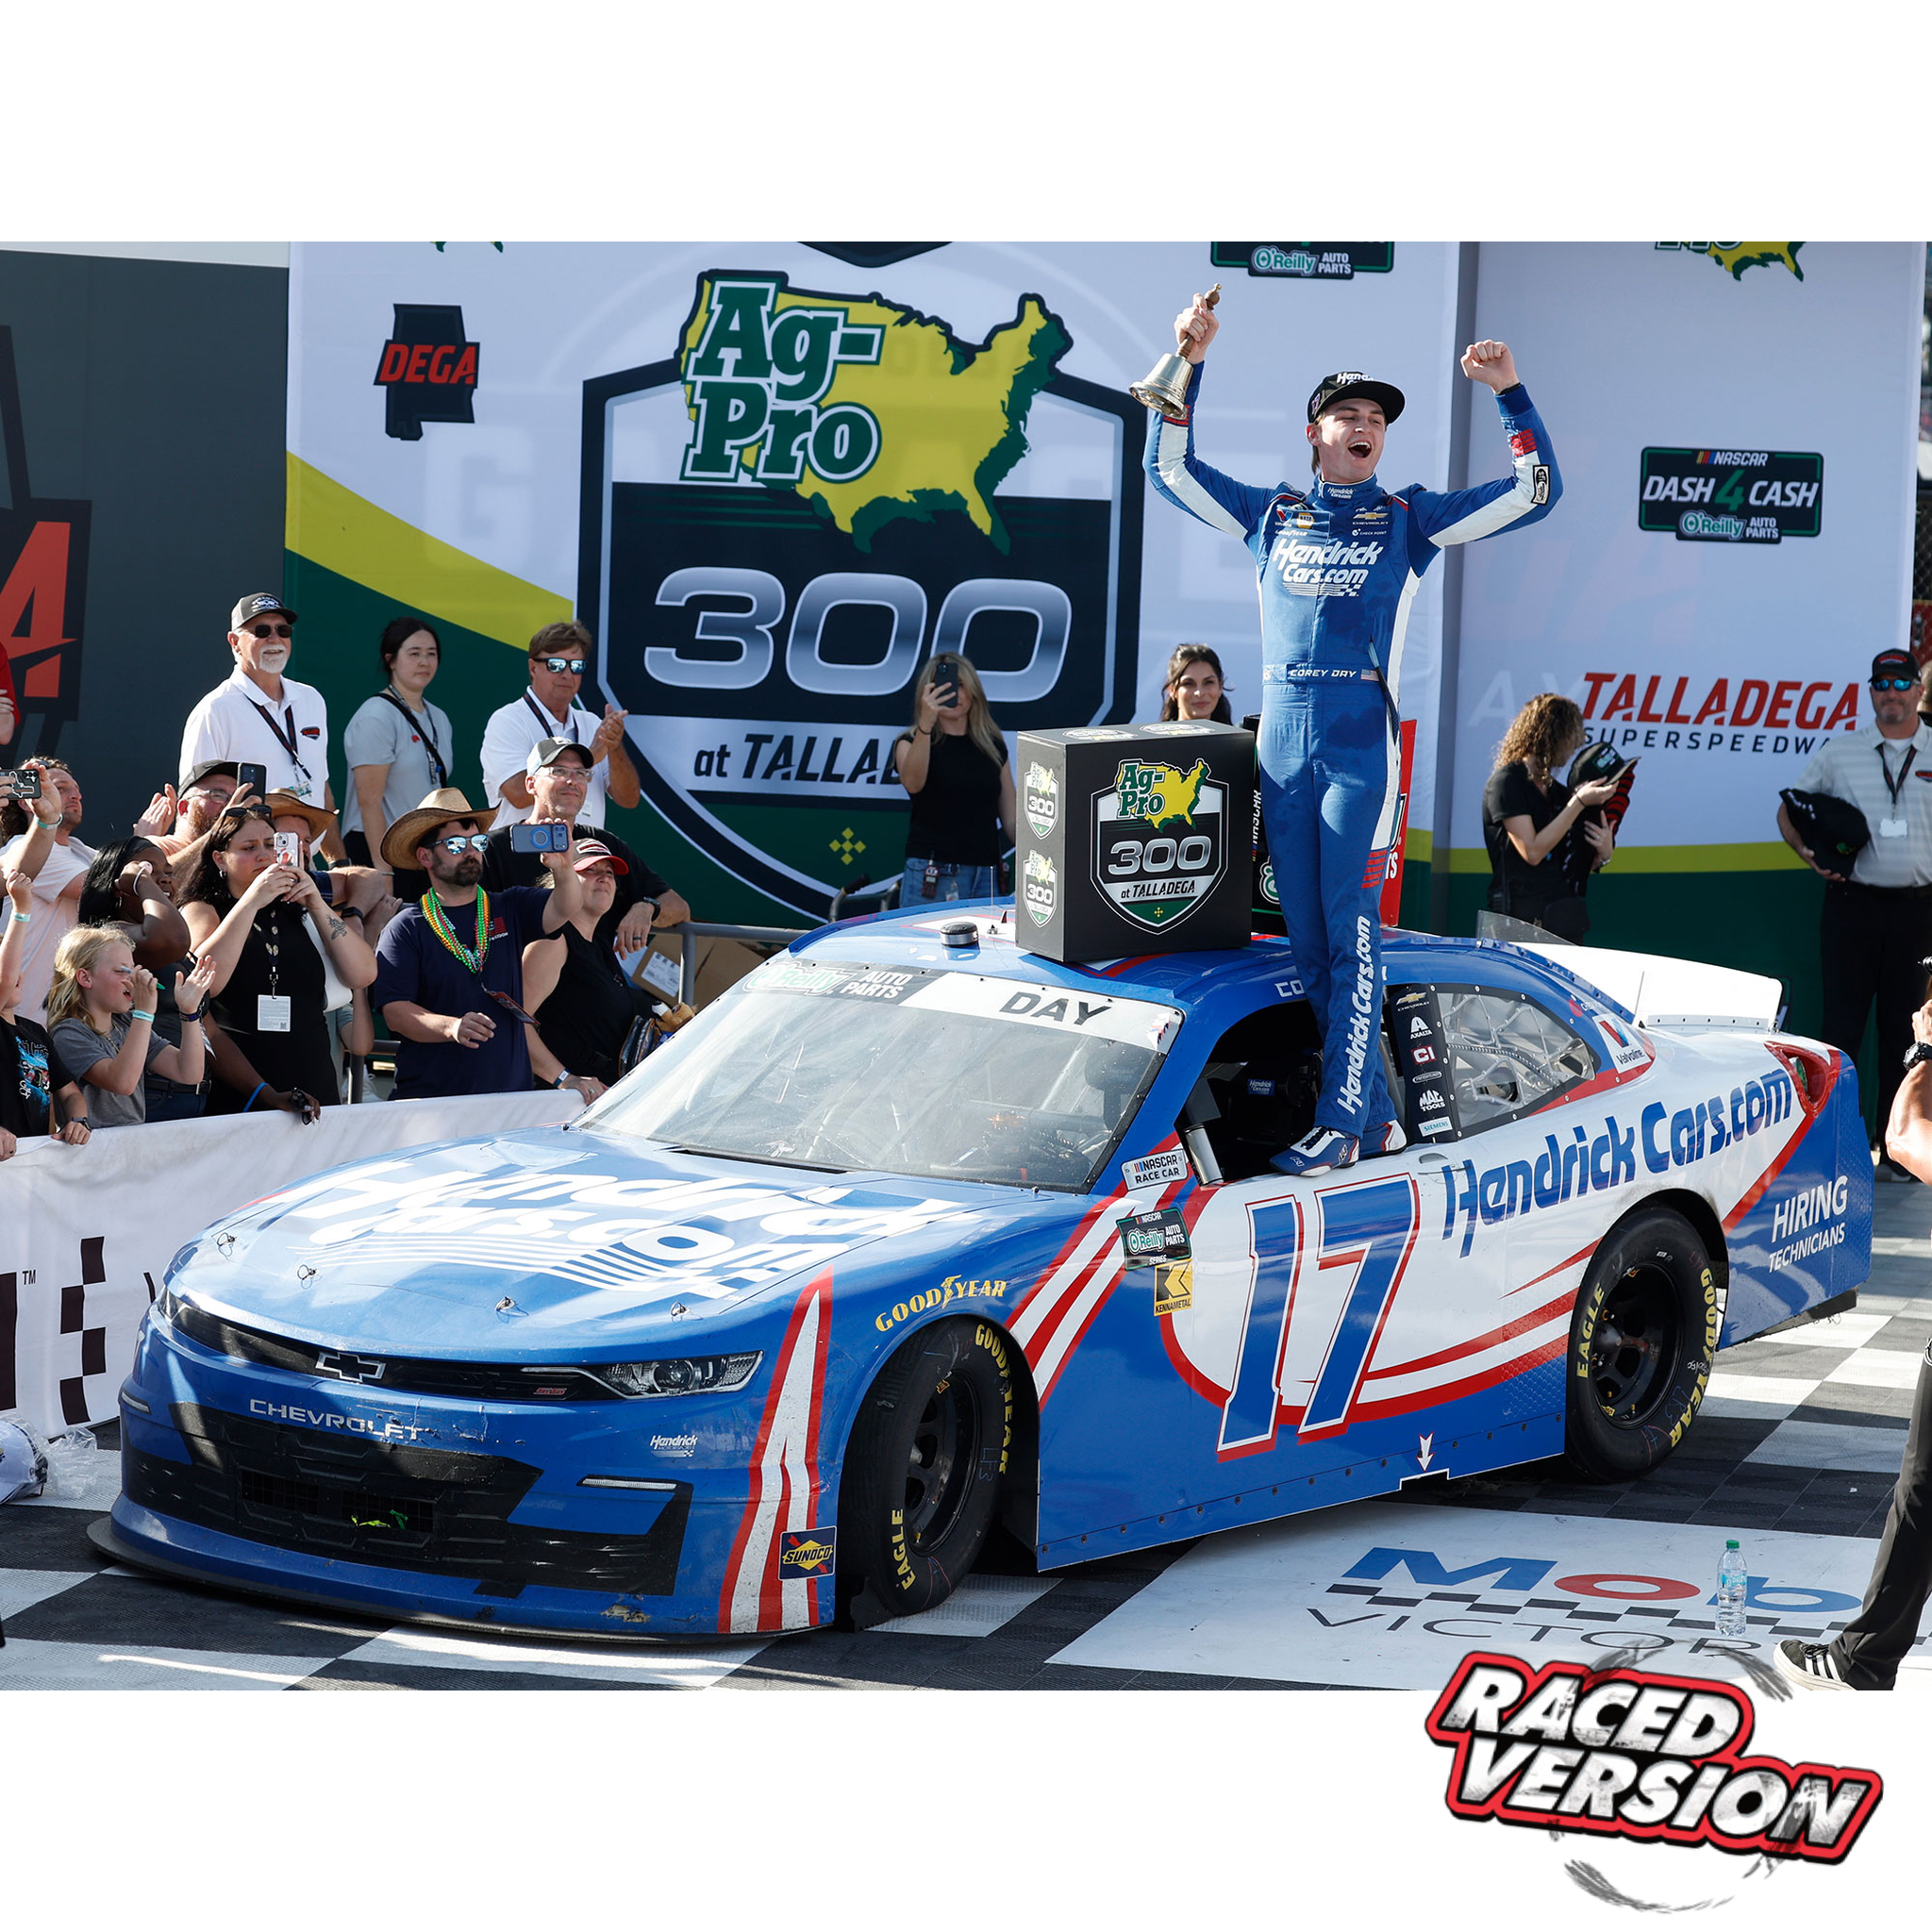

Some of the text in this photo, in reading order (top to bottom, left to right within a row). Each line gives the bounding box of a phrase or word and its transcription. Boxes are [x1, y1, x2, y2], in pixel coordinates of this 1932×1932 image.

[1255, 248, 1317, 273] O'Reilly
[1322, 252, 1350, 263] AUTO
[1318, 263, 1352, 275] PARTS
[688, 280, 886, 406] Ag-
[378, 344, 477, 384] DEGA
[682, 379, 881, 482] Pro
[1713, 451, 1769, 467] NASCAR
[1642, 469, 1820, 511] DASH 4 CASH
[1683, 512, 1743, 539] O'Reilly
[1750, 517, 1776, 527] AUTO
[1746, 527, 1779, 539] PARTS
[1273, 538, 1384, 570] Hendrick
[1283, 564, 1369, 584] Cars.com
[644, 566, 1073, 703] 300
[1290, 669, 1328, 677] COREY
[1583, 672, 1861, 731] TALLADEGA
[693, 743, 731, 777] at
[1119, 762, 1165, 793] Ag-
[1028, 795, 1055, 816] 300
[1117, 791, 1164, 819] Pro
[1108, 835, 1212, 875] 300
[1026, 883, 1054, 905] 300
[1121, 879, 1195, 899] at TALLADEGA
[860, 971, 913, 986] AUTO
[840, 982, 904, 999] PARTS
[998, 991, 1111, 1026] DAY
[1397, 1001, 1430, 1012] CHEVROLET
[1410, 1029, 1433, 1040] AXALTA
[1413, 1046, 1435, 1063] CI
[1616, 1048, 1646, 1066] Valvoline
[1419, 1090, 1443, 1107] MAC
[1421, 1102, 1446, 1111] TOOLS
[1424, 1121, 1449, 1131] SIEMENS
[1142, 1154, 1178, 1171] NASCAR
[1135, 1167, 1180, 1184] RACE CAR
[1141, 1211, 1163, 1224] NASCAR
[1771, 1174, 1849, 1242] HIRING
[1165, 1224, 1181, 1236] AUTO
[1165, 1234, 1186, 1246] PARTS
[1128, 1229, 1164, 1253] O'Reilly
[1769, 1223, 1845, 1274] TECHNICIANS
[1149, 1255, 1167, 1266] SERIES
[23, 1270, 37, 1286] TM
[875, 1274, 1007, 1332] GOODYEAR
[1155, 1297, 1191, 1314] KENNAMETAL
[1217, 1173, 1421, 1462] 17
[1576, 1282, 1605, 1378] EAGLE
[249, 1398, 421, 1442] CHEVROLET
[649, 1434, 698, 1450] Hendrick
[784, 1546, 832, 1565] SUNOCO
[891, 1508, 916, 1589] EAGLE
[1341, 1547, 1863, 1613] Mob
[1307, 1607, 1762, 1657] VICTOR
